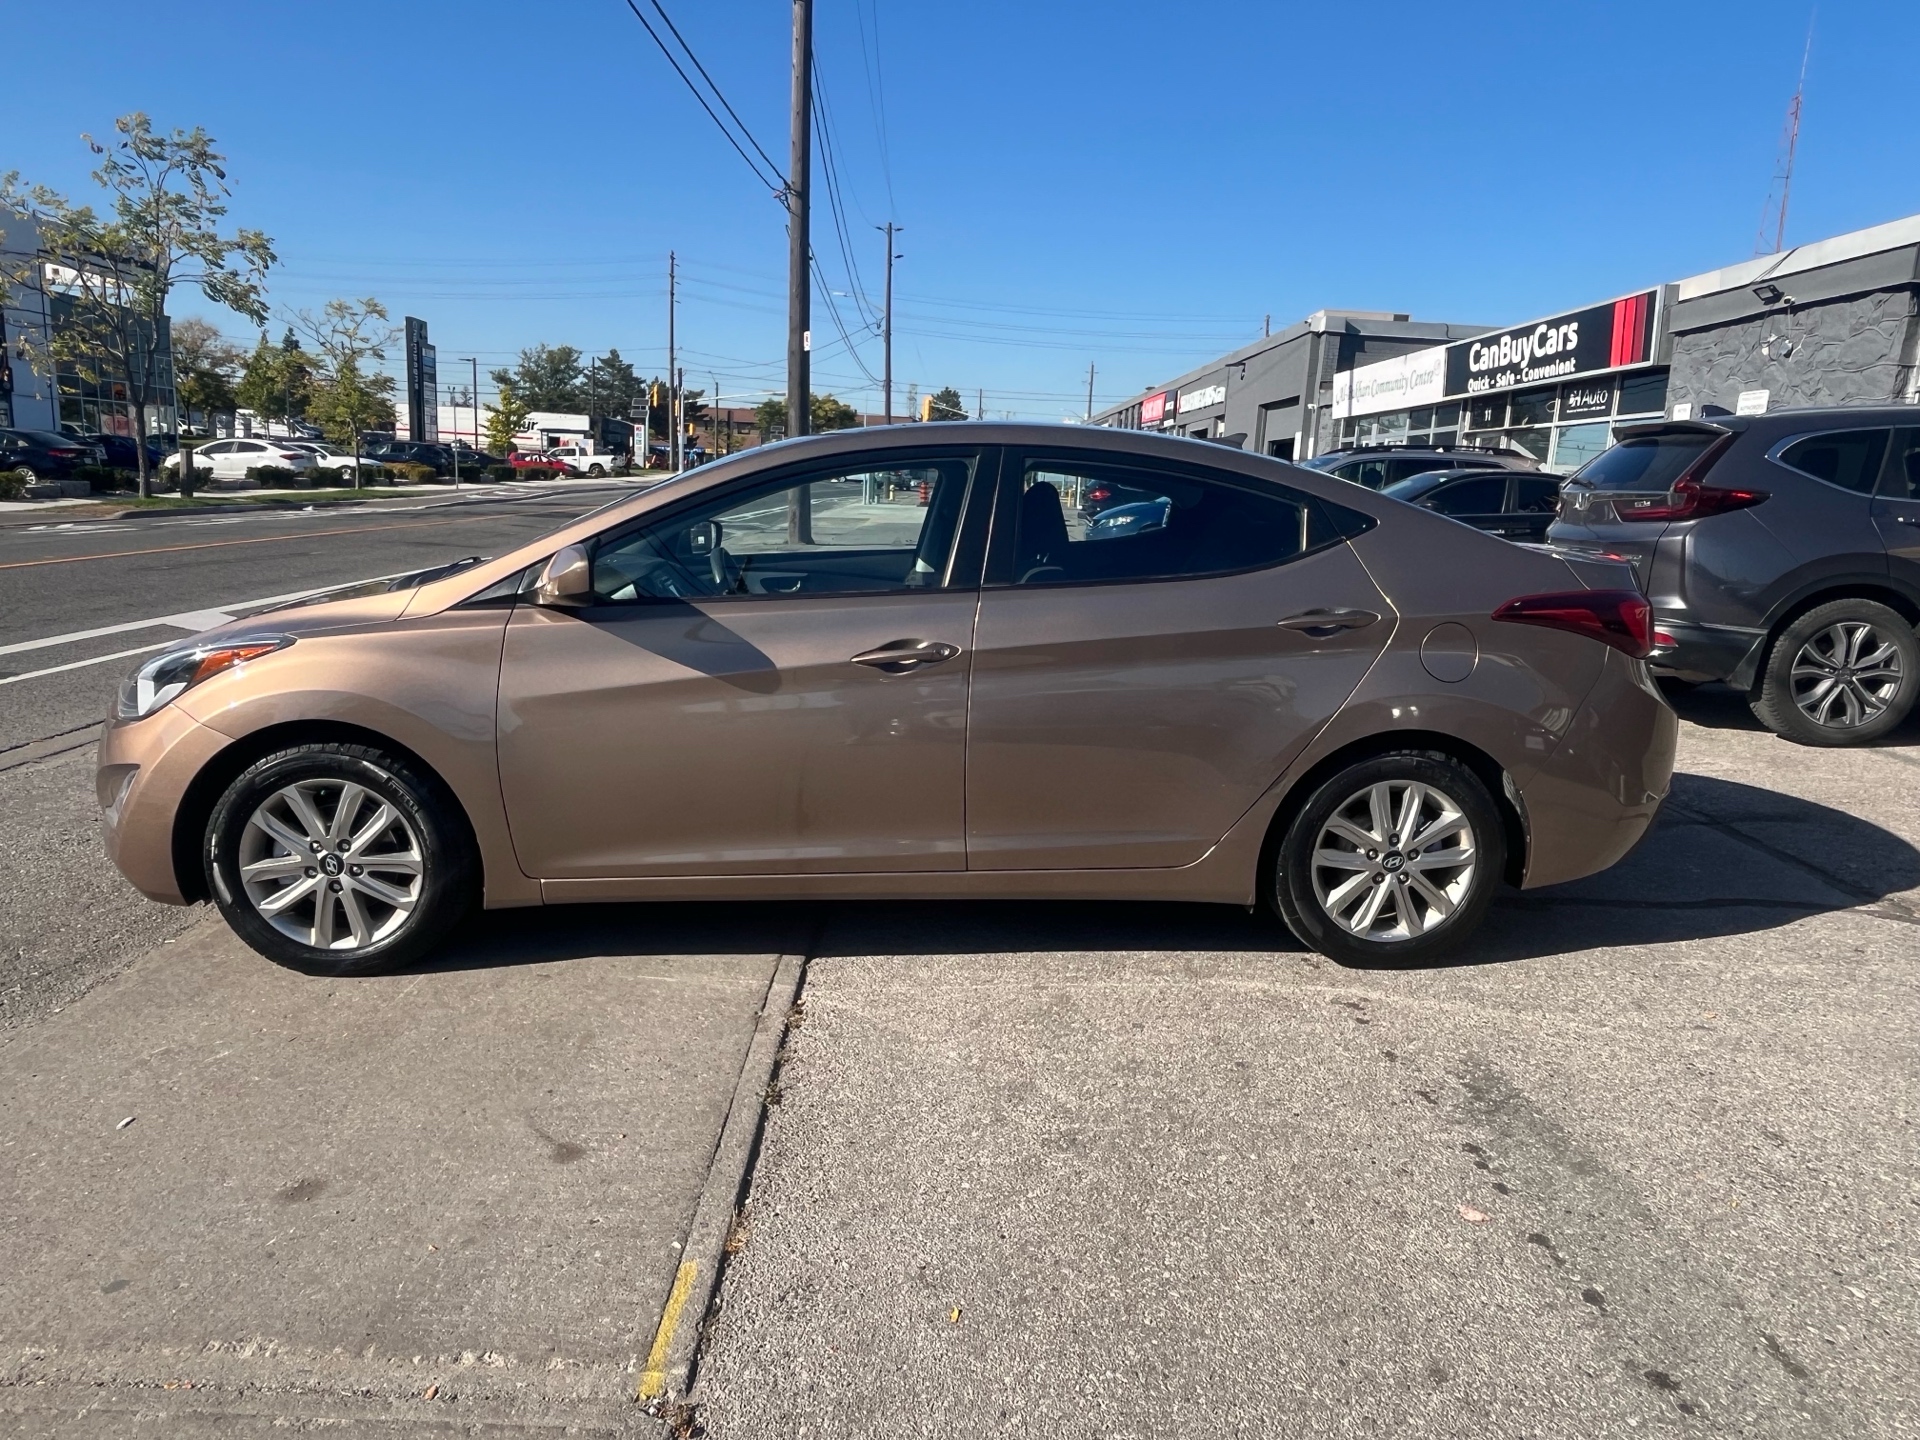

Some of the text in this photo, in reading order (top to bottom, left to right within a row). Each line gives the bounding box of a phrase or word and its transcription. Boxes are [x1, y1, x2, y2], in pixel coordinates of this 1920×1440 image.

[1469, 322, 1579, 372] CanBuyCars
[1371, 372, 1409, 397] Community
[1410, 370, 1434, 390] Centre
[1468, 374, 1490, 393] Quick
[1496, 370, 1515, 387] Safe
[1522, 357, 1576, 382] Convenient
[1581, 388, 1608, 405] Auto
